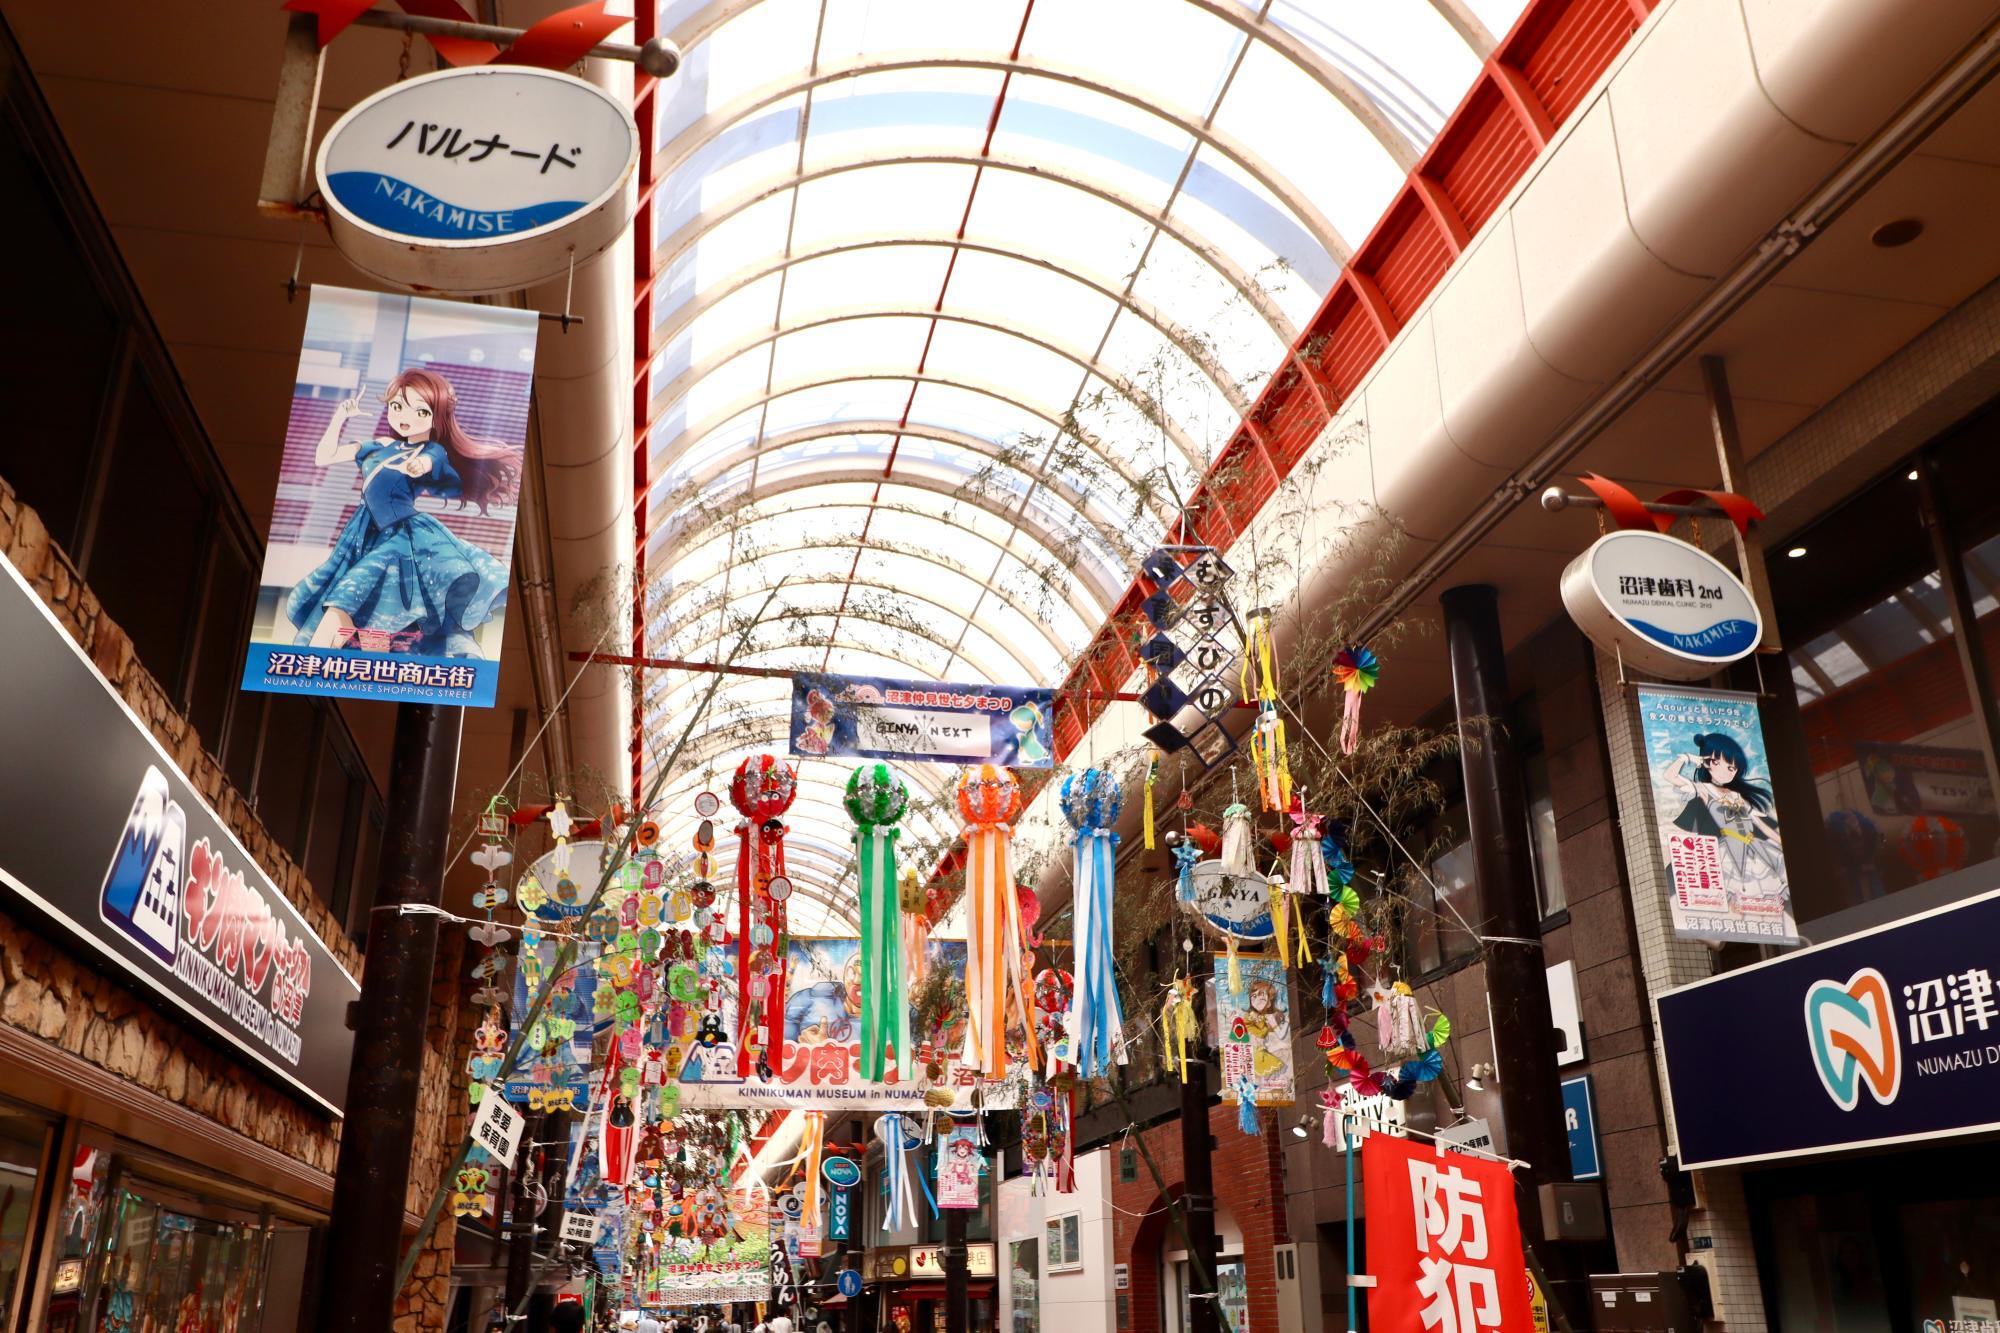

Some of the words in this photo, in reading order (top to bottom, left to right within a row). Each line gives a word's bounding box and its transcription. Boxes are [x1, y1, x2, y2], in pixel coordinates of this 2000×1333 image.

[387, 121, 582, 174] パルナード
[374, 176, 516, 233] NAKAMISE
[1618, 576, 1695, 598] 沼津歯科
[1698, 585, 1723, 600] 2nd
[1673, 620, 1742, 649] NAKAMISE
[267, 651, 475, 690] 沼津仲見世商店街
[264, 677, 312, 689] NUMAZU
[316, 681, 373, 693] NAKAMISE
[377, 685, 435, 697] SHOPPING
[437, 688, 474, 699] STREET
[885, 689, 1013, 711] 沼津仲見世七夕まつり
[876, 720, 919, 735] GINYA
[176, 939, 235, 1016] KINNIKUMAN
[1903, 968, 2000, 1045] 沼津
[1916, 1049, 1983, 1077] NUMAZU
[1986, 1046, 2000, 1065] D
[738, 1087, 812, 1099] KINNIKUMAN
[816, 1088, 867, 1099] MUSEUM
[871, 1089, 878, 1099] in
[884, 1089, 926, 1101] NUMAZ
[1565, 1107, 1579, 1131] R
[480, 1121, 510, 1158] 保育園
[1446, 1135, 1490, 1155] すびの保育園
[834, 1193, 847, 1235] NOVA
[1407, 1158, 1503, 1333] 防犯
